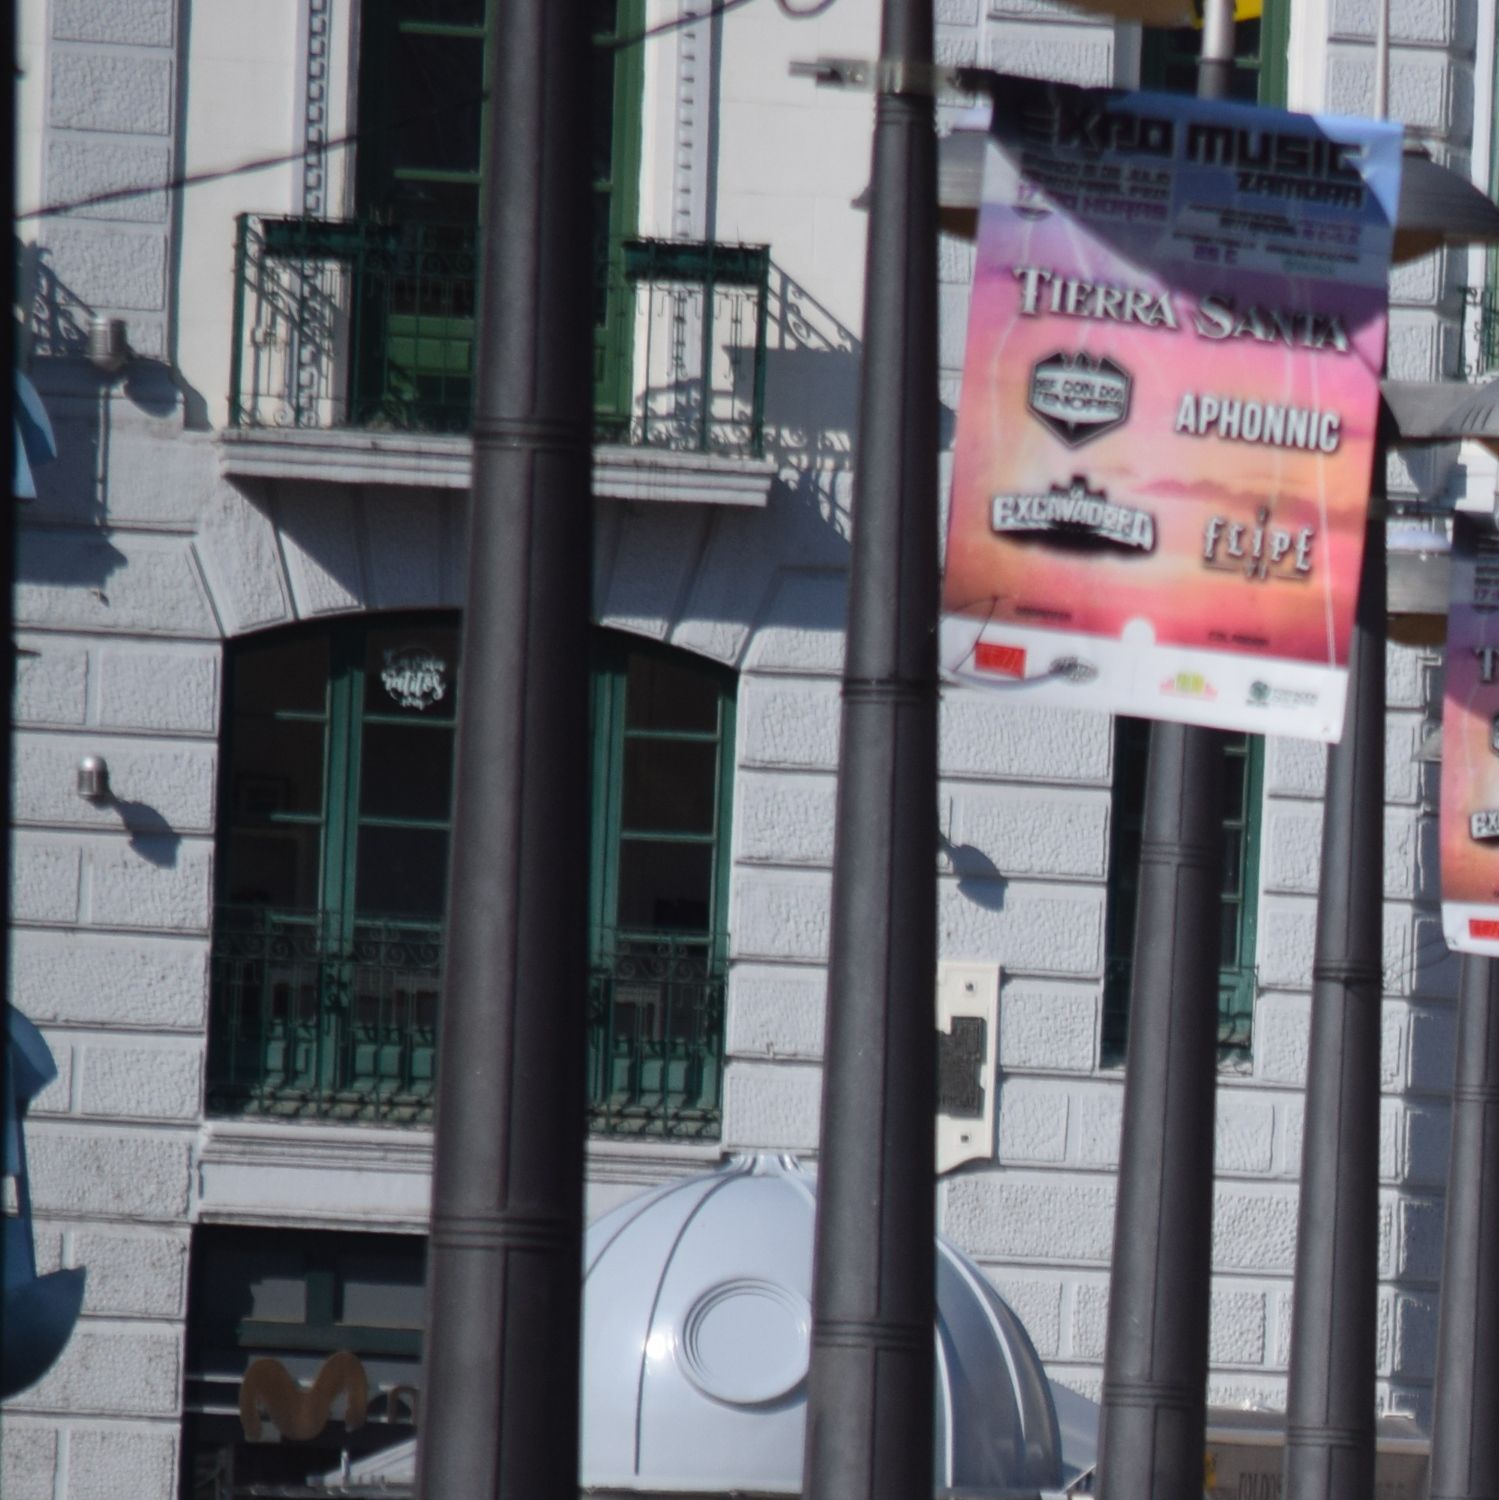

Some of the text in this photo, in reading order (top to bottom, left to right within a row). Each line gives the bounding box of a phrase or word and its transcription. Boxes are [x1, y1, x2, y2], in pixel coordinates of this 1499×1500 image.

[1188, 119, 1366, 179] MUSIC
[1013, 266, 1352, 354] TIERRA SANTA
[1175, 391, 1341, 454] APHONNIC
[991, 495, 1154, 552] EXCAVADORA
